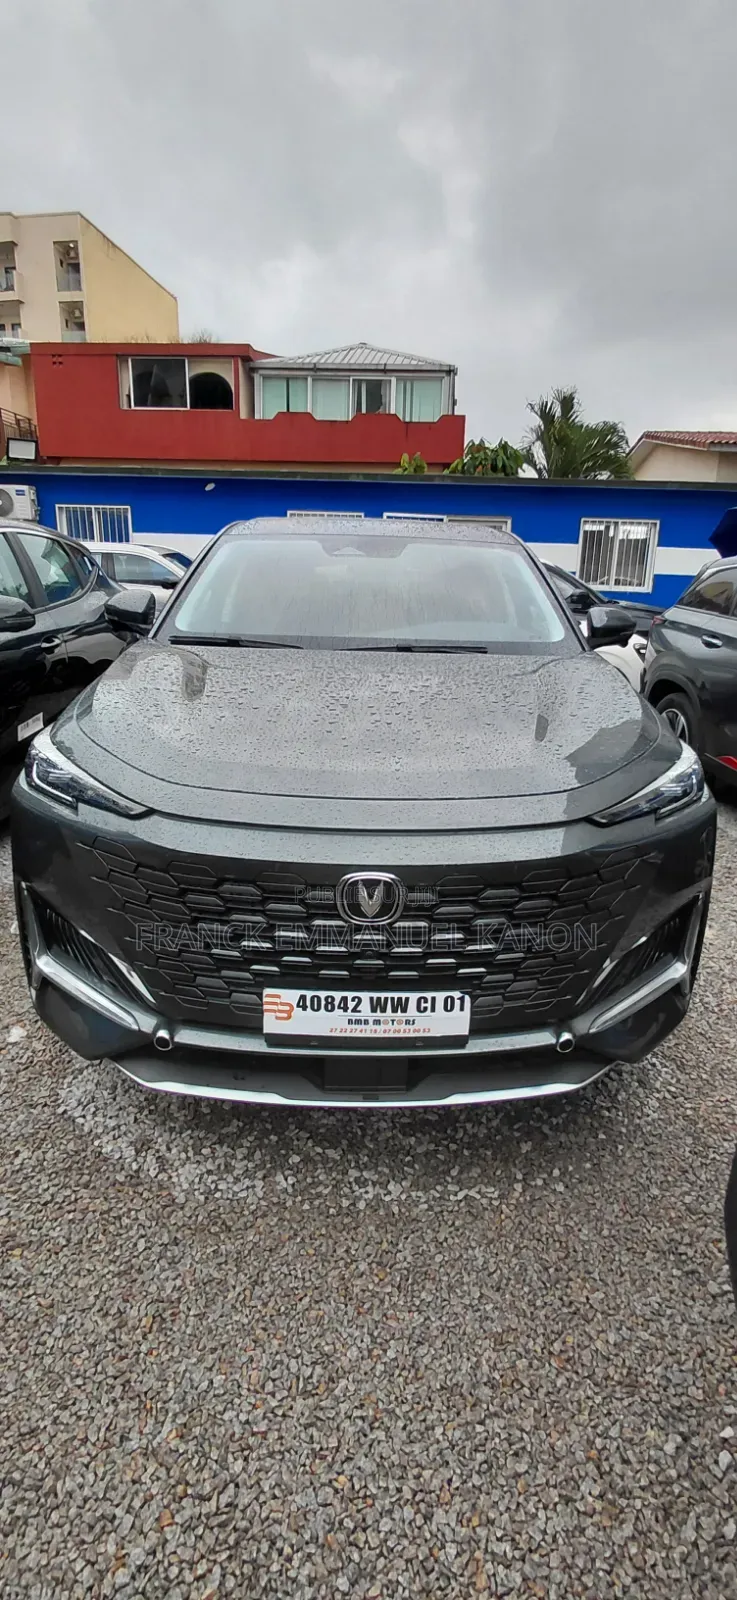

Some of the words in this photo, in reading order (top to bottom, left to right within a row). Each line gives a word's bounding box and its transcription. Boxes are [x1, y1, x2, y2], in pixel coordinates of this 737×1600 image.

[296, 994, 363, 1013] 40842
[369, 996, 410, 1013] WW
[416, 996, 437, 1013] CI
[443, 995, 466, 1012] 01
[347, 1018, 370, 1026] BMB
